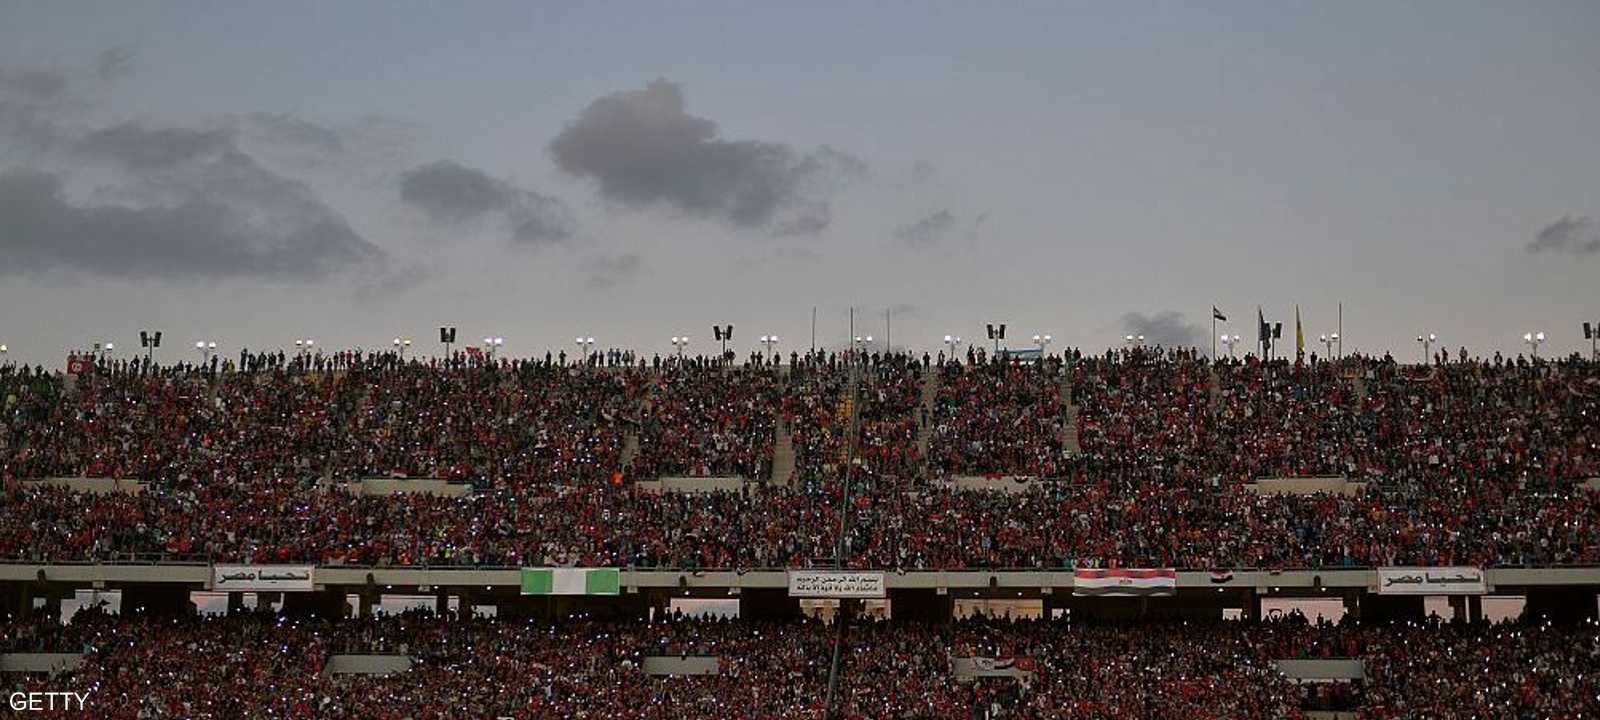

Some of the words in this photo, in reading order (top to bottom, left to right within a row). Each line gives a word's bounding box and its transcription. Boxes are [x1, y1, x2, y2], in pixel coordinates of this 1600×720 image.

[217, 572, 256, 584] مصر
[258, 569, 310, 584] تحيا
[1383, 575, 1424, 587] مصر
[1425, 572, 1481, 587] تحيا
